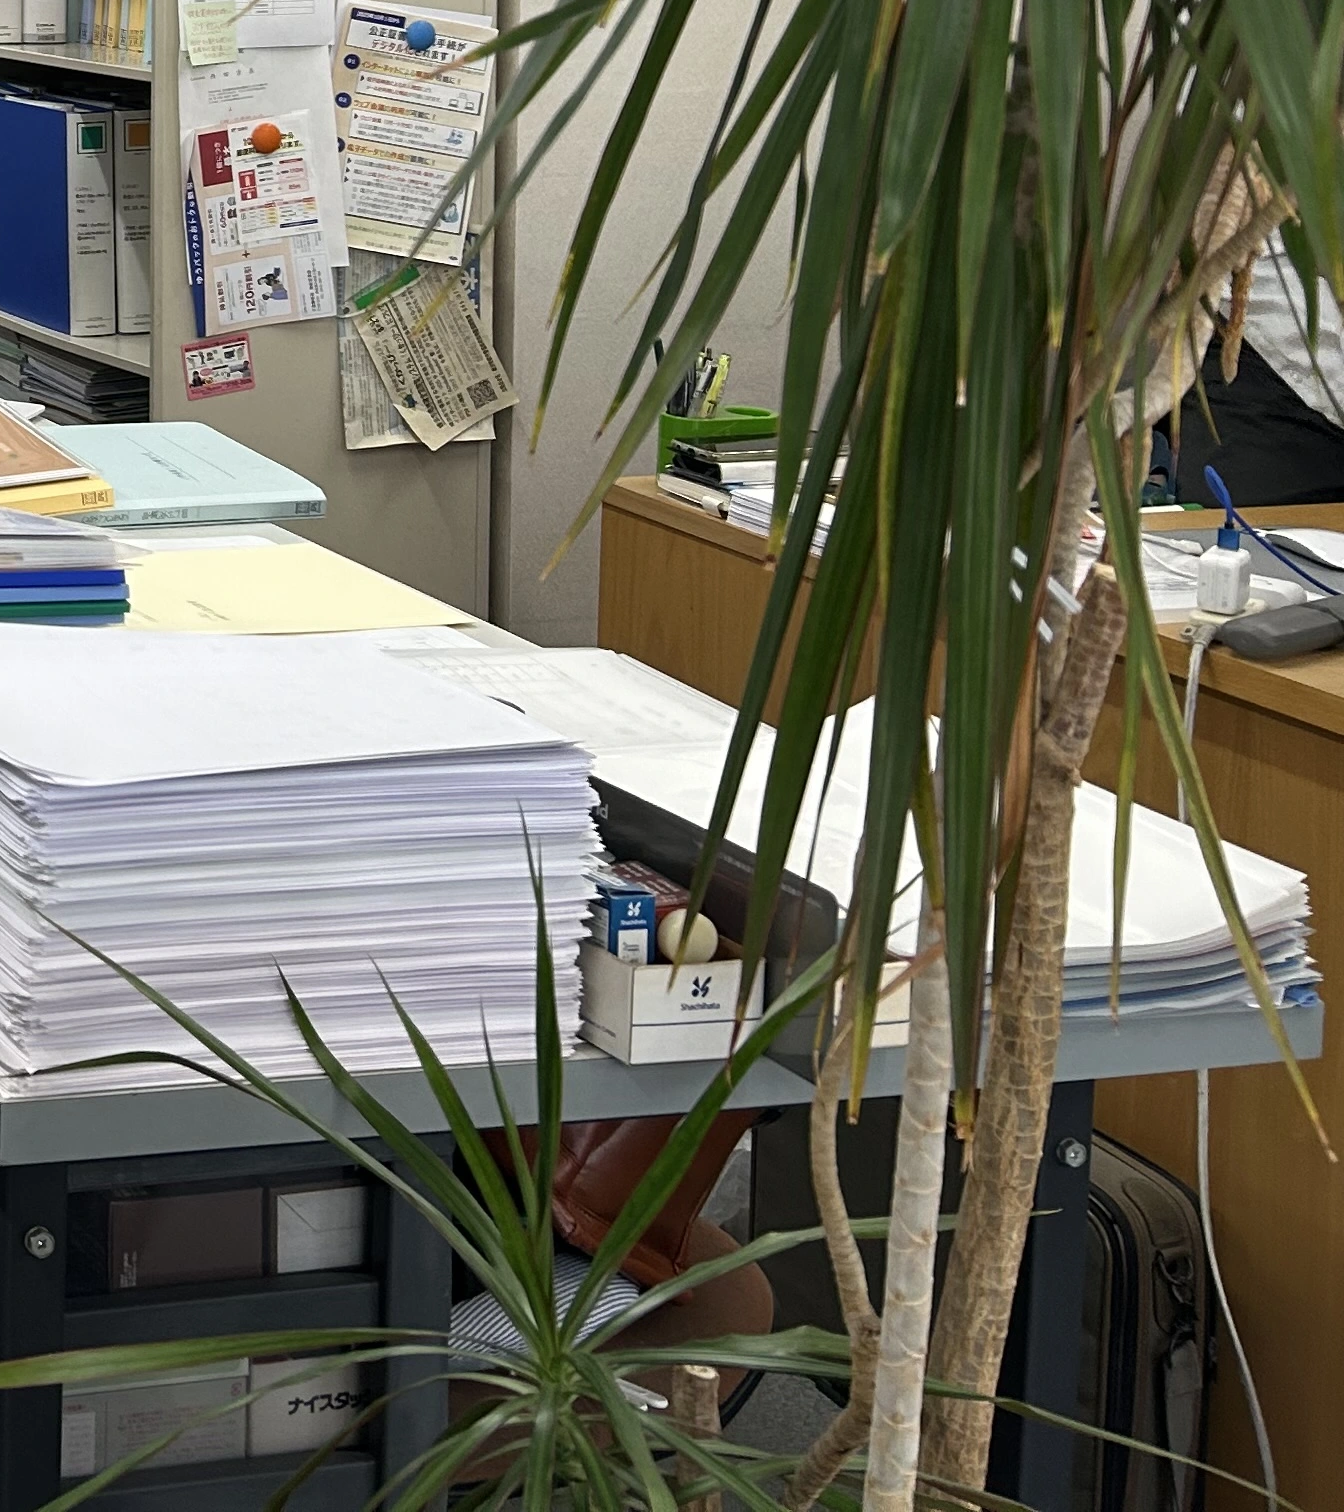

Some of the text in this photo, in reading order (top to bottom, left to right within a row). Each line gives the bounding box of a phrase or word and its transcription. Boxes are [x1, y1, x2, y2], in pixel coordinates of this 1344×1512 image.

[368, 25, 468, 52] 公正証書手続が
